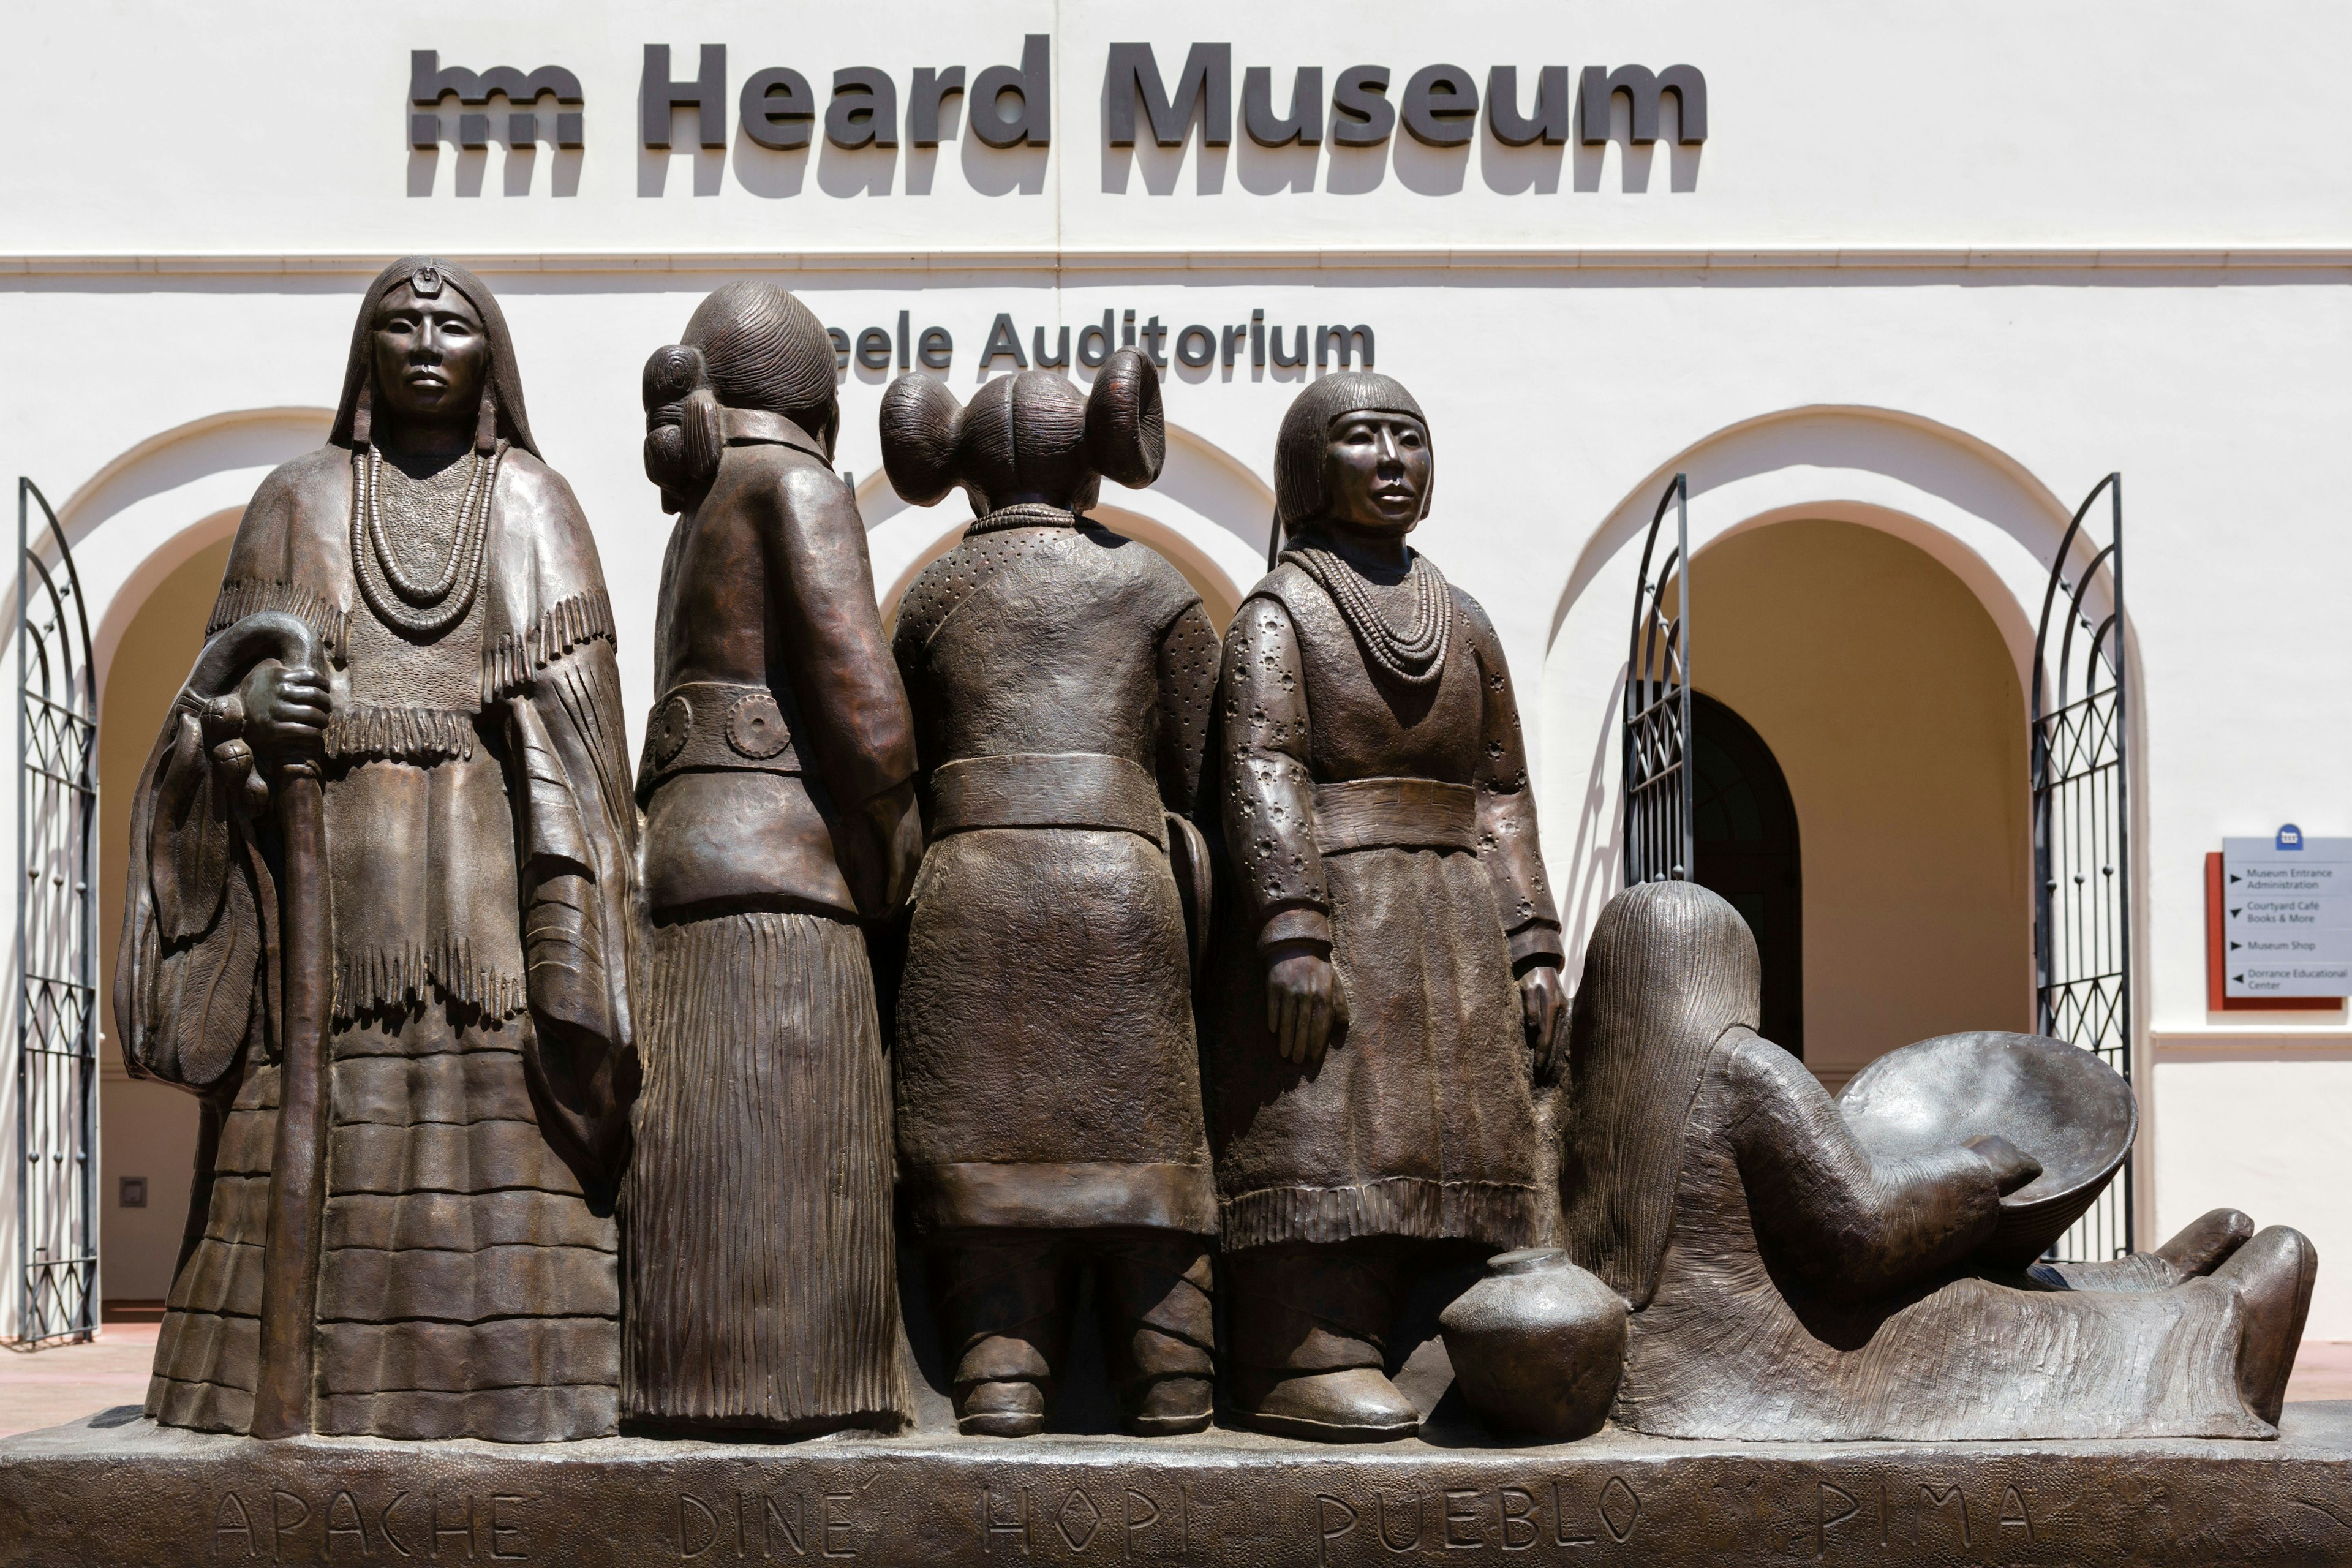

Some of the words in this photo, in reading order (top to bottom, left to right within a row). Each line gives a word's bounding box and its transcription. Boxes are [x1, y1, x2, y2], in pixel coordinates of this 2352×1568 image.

[643, 34, 1050, 151] Heard
[1108, 42, 1708, 149] Museum
[979, 307, 1375, 369] Auditorium
[2247, 869, 2288, 878] Museum
[2290, 869, 2333, 878] Entrance
[2247, 880, 2319, 889] Administration
[2247, 901, 2296, 912] Courtyard
[2297, 900, 2320, 911] Café
[2247, 914, 2277, 923] Books
[2278, 914, 2286, 923] &
[2289, 914, 2315, 923] More
[2248, 941, 2290, 950] Museum
[2291, 941, 2316, 951] Shop
[2248, 969, 2291, 978] Dorrance
[2293, 969, 2348, 978] Educational
[2248, 981, 2281, 990] Center
[214, 1490, 529, 1564] APACHE
[982, 1486, 1188, 1560] HOPI
[1316, 1475, 1642, 1568] PUEBLO
[1815, 1480, 2037, 1561] PIMA
